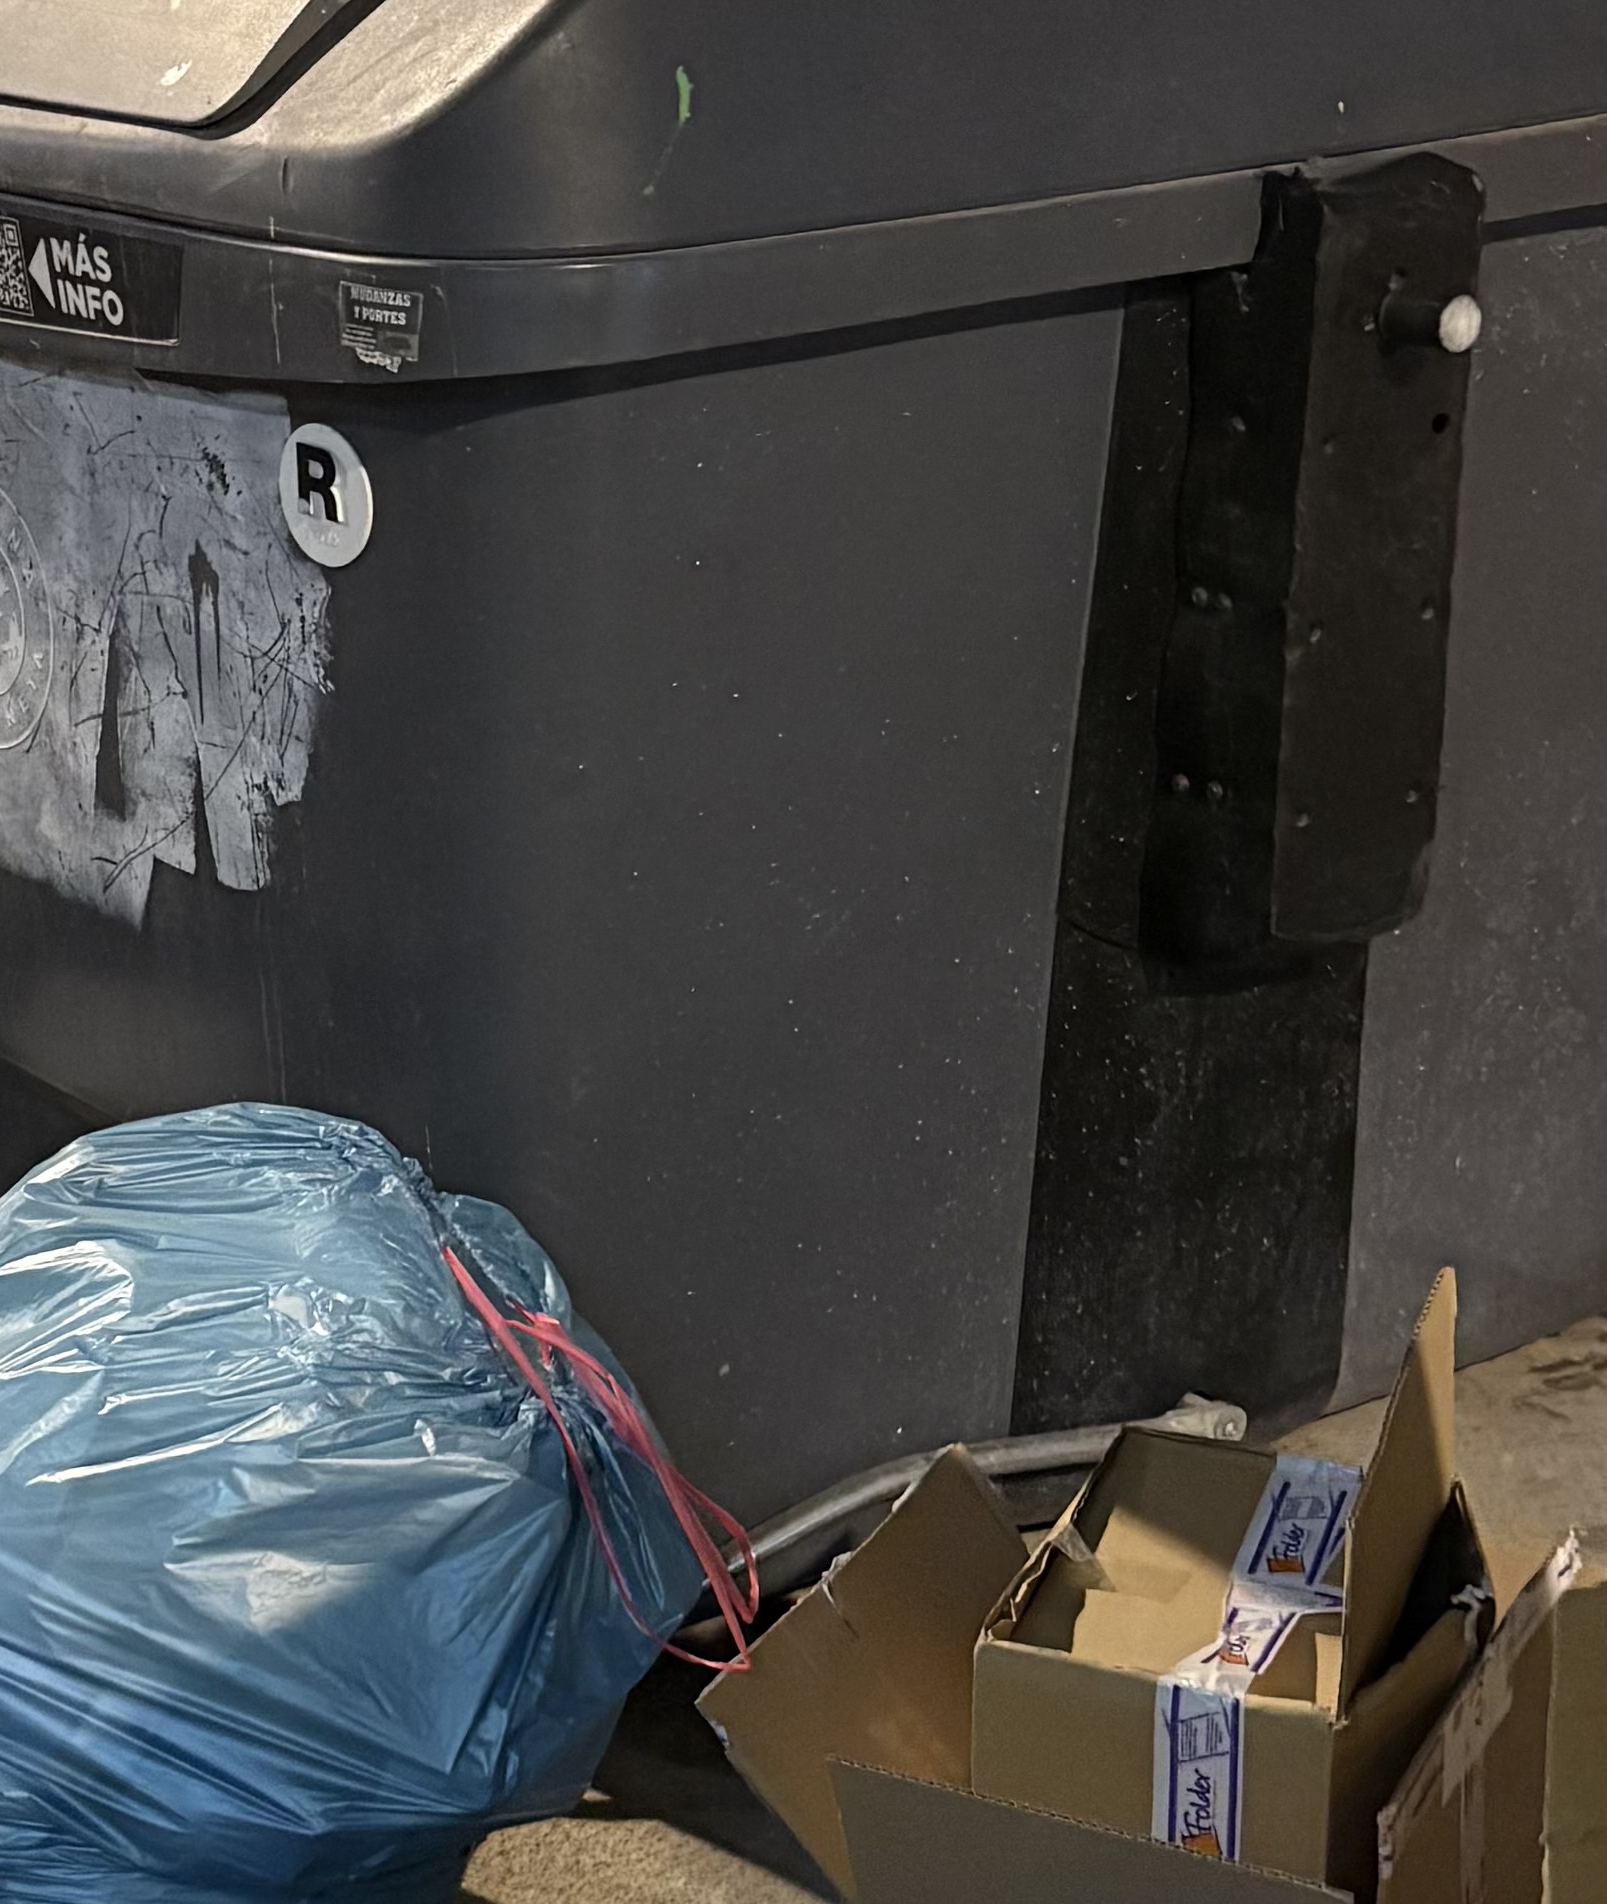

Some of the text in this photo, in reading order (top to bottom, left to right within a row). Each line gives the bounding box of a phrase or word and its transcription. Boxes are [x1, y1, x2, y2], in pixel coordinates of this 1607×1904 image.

[49, 232, 113, 283] MÁS
[57, 278, 124, 326] INFO
[350, 284, 411, 307] MUDANZAS
[362, 306, 407, 326] PORTES
[296, 441, 344, 524] R
[1184, 1767, 1212, 1836] Folder
